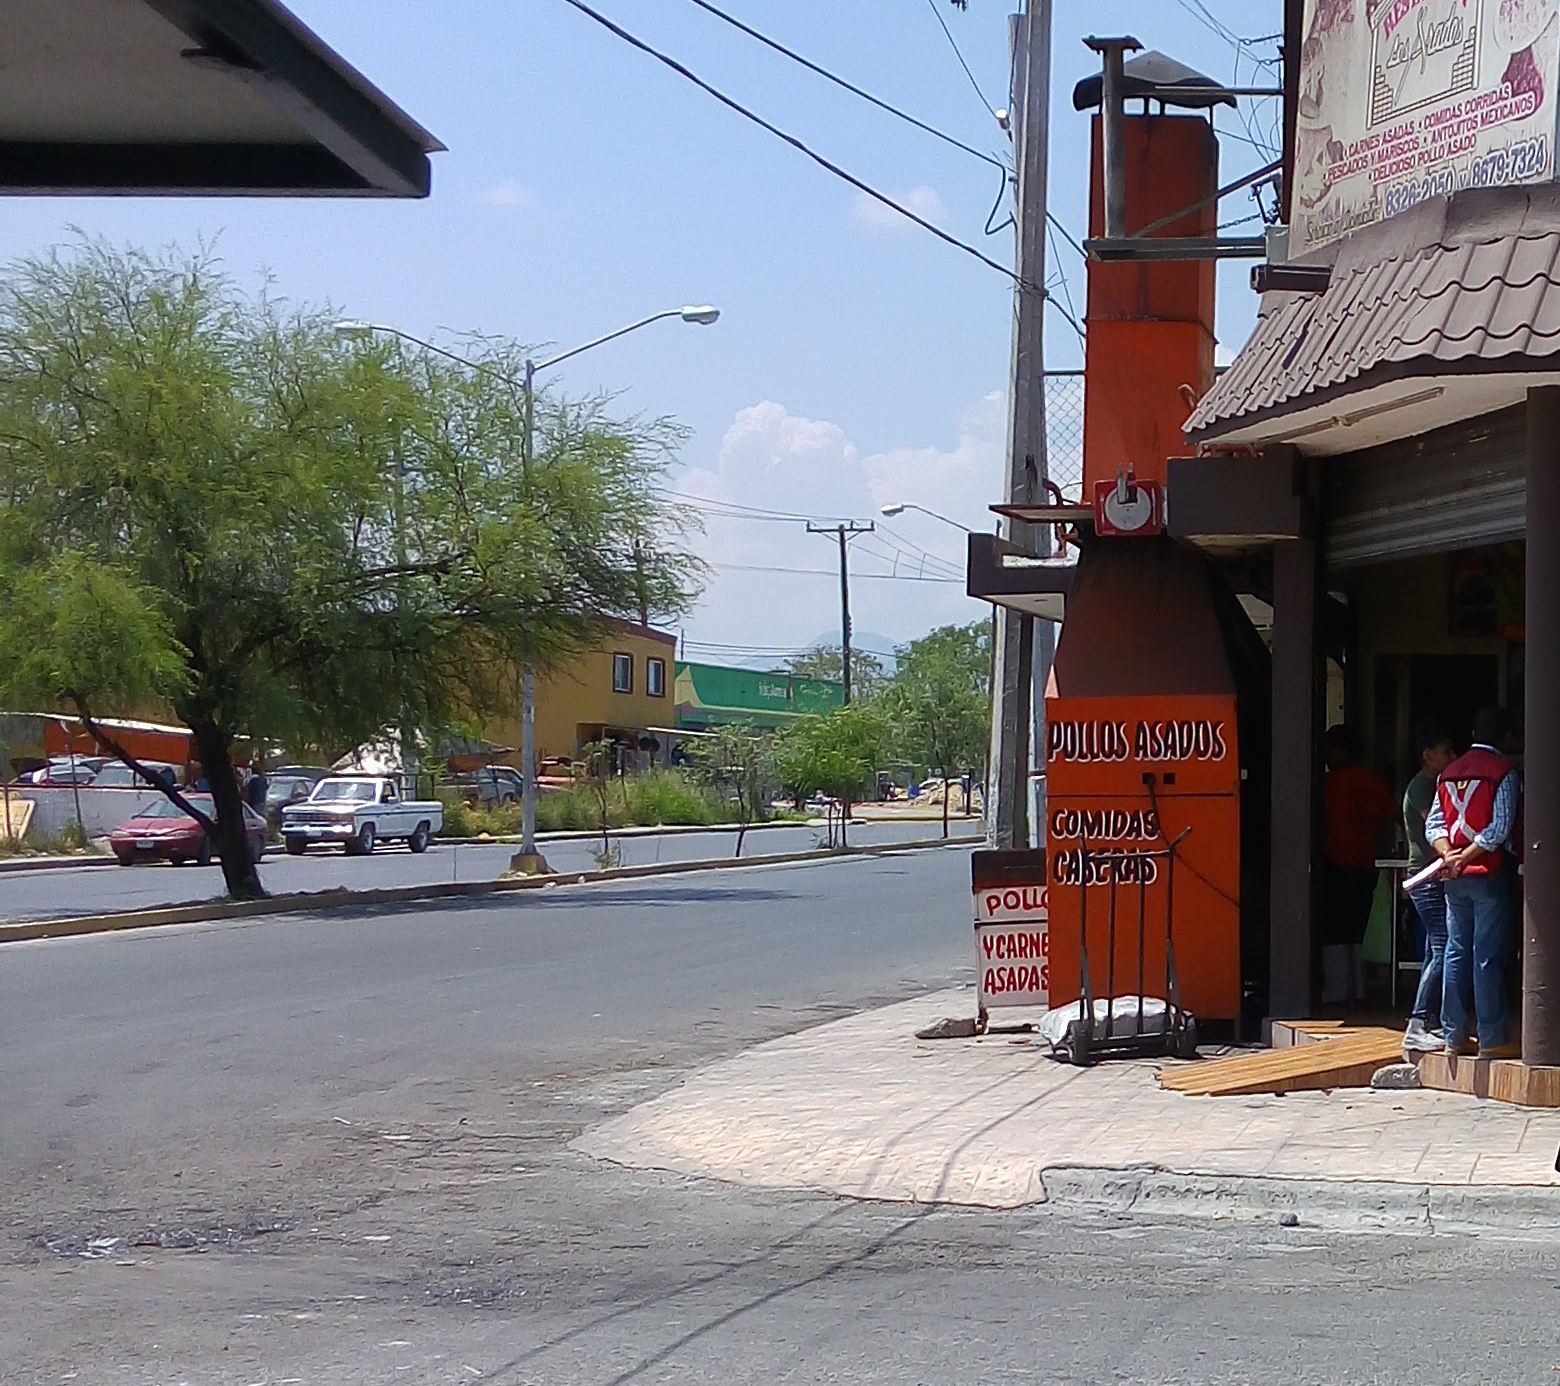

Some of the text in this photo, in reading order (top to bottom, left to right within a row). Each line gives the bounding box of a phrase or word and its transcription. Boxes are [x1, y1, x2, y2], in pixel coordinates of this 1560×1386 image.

[1327, 157, 1368, 180] PESCADOS
[1376, 136, 1420, 163] MARISCOS
[1430, 115, 1478, 145] ANTOJITOS
[1479, 94, 1535, 128] MEXICANOS
[1349, 85, 1511, 157] CARNES ASADAS COMIDAS CORRIDAS
[1373, 133, 1477, 182] DELICIOSO POLLO ASADO
[1472, 137, 1547, 187] 8679-7324
[1048, 719, 1227, 762] POLLOS ASADOS
[1051, 808, 1159, 841] COMIDAS
[984, 965, 1048, 995] ASADAS
